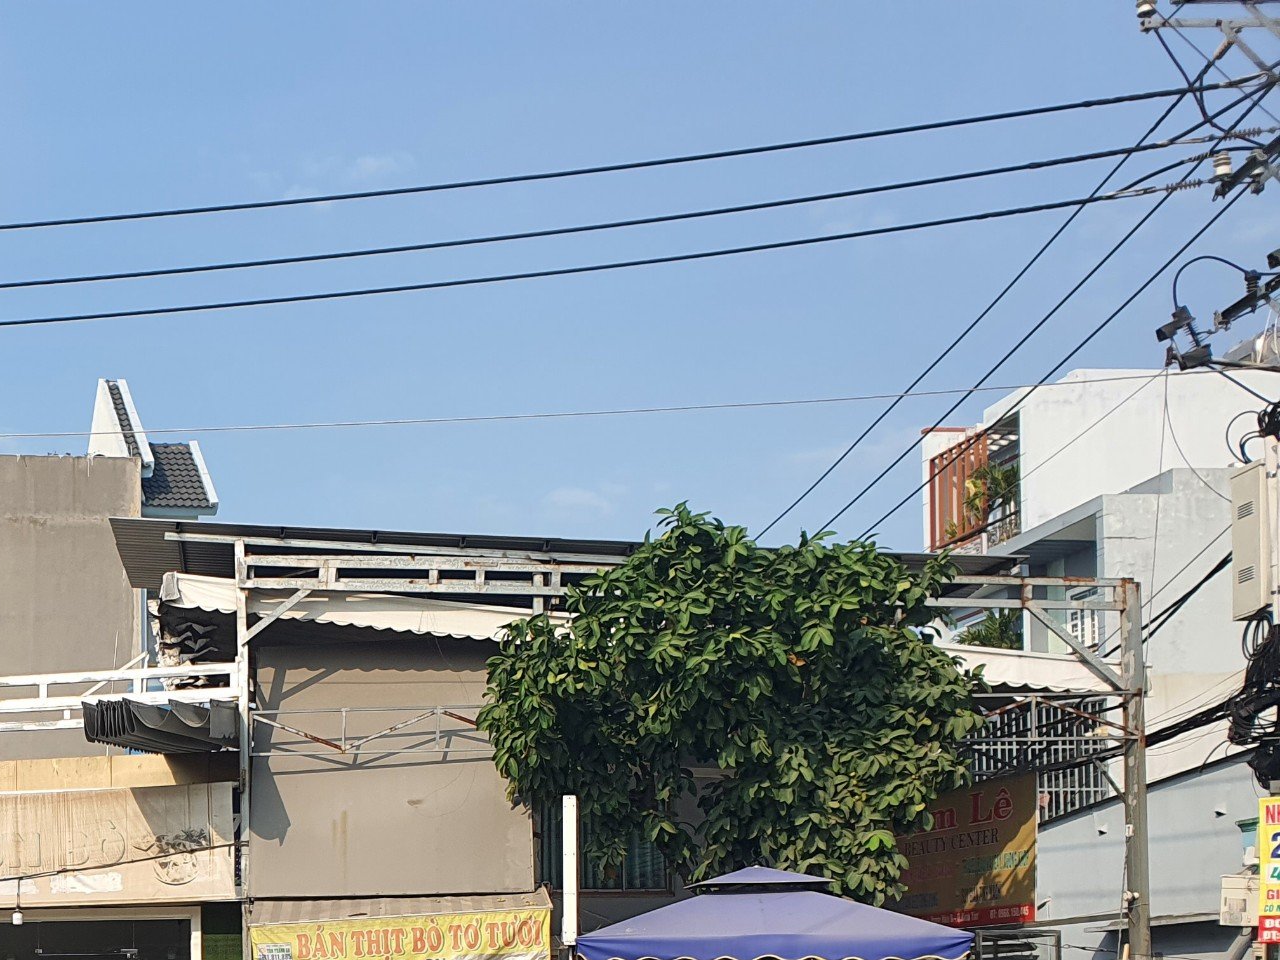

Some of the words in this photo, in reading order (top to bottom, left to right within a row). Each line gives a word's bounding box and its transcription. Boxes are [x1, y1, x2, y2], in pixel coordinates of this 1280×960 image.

[970, 786, 1014, 823] Lê
[904, 836, 947, 856] BEAUTY
[951, 827, 999, 850] CENTER
[296, 925, 346, 960] BÁN
[410, 918, 446, 955] BÒ
[448, 917, 482, 952] TƠ
[486, 914, 543, 950] TƯƠI
